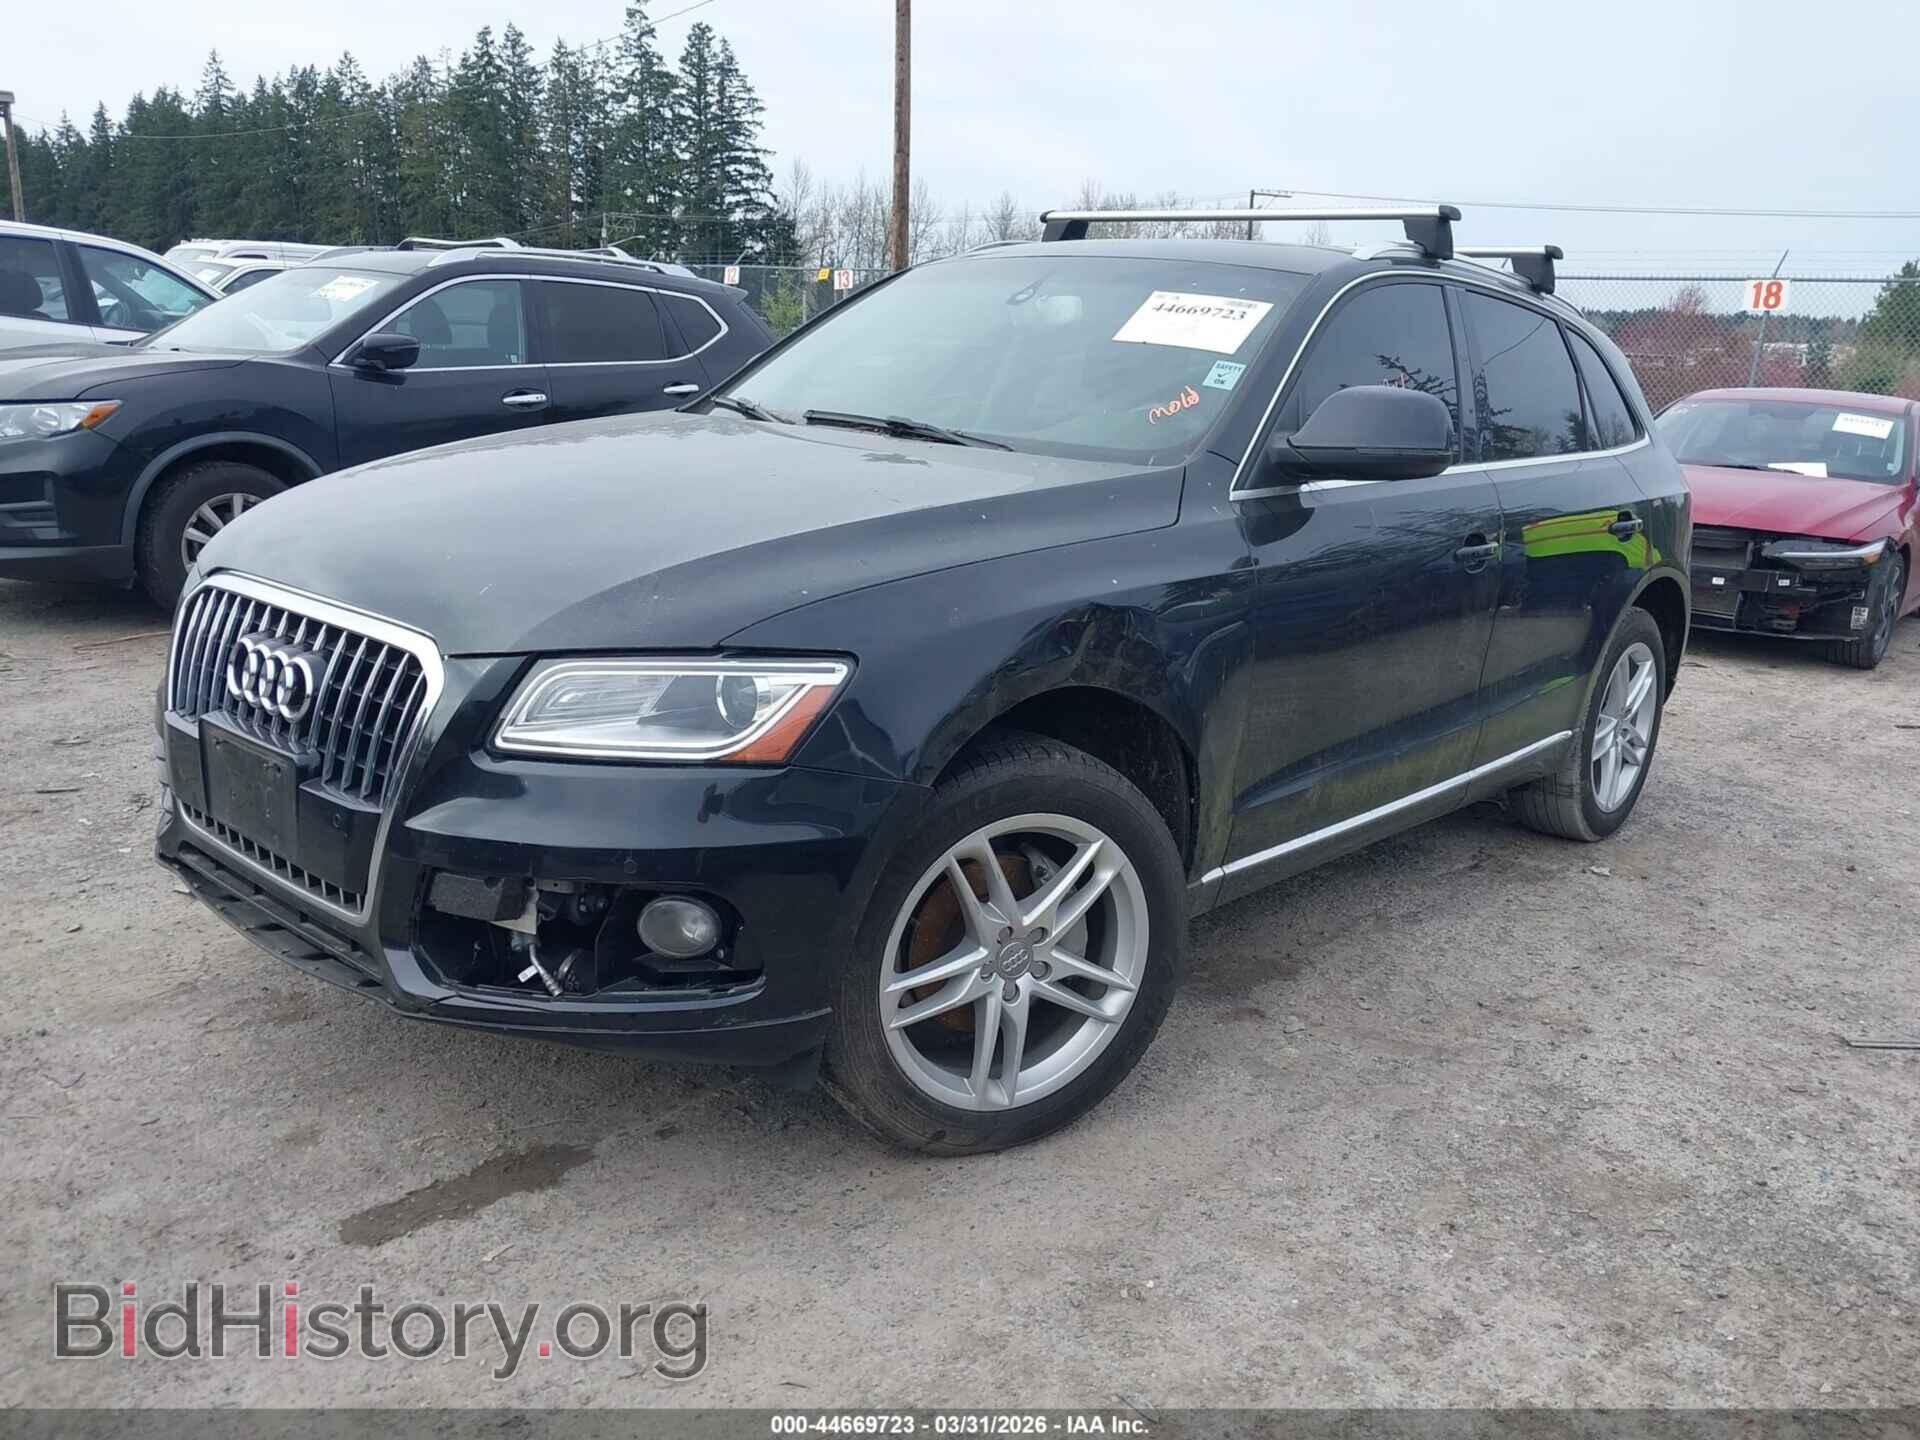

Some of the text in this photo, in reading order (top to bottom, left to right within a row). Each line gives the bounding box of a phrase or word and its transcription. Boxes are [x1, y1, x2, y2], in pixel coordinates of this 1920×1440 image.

[727, 267, 737, 283] 12
[837, 270, 850, 288] 13
[1752, 280, 1783, 309] 18
[1151, 302, 1247, 321] 44669723
[1214, 362, 1242, 372] SAFETY
